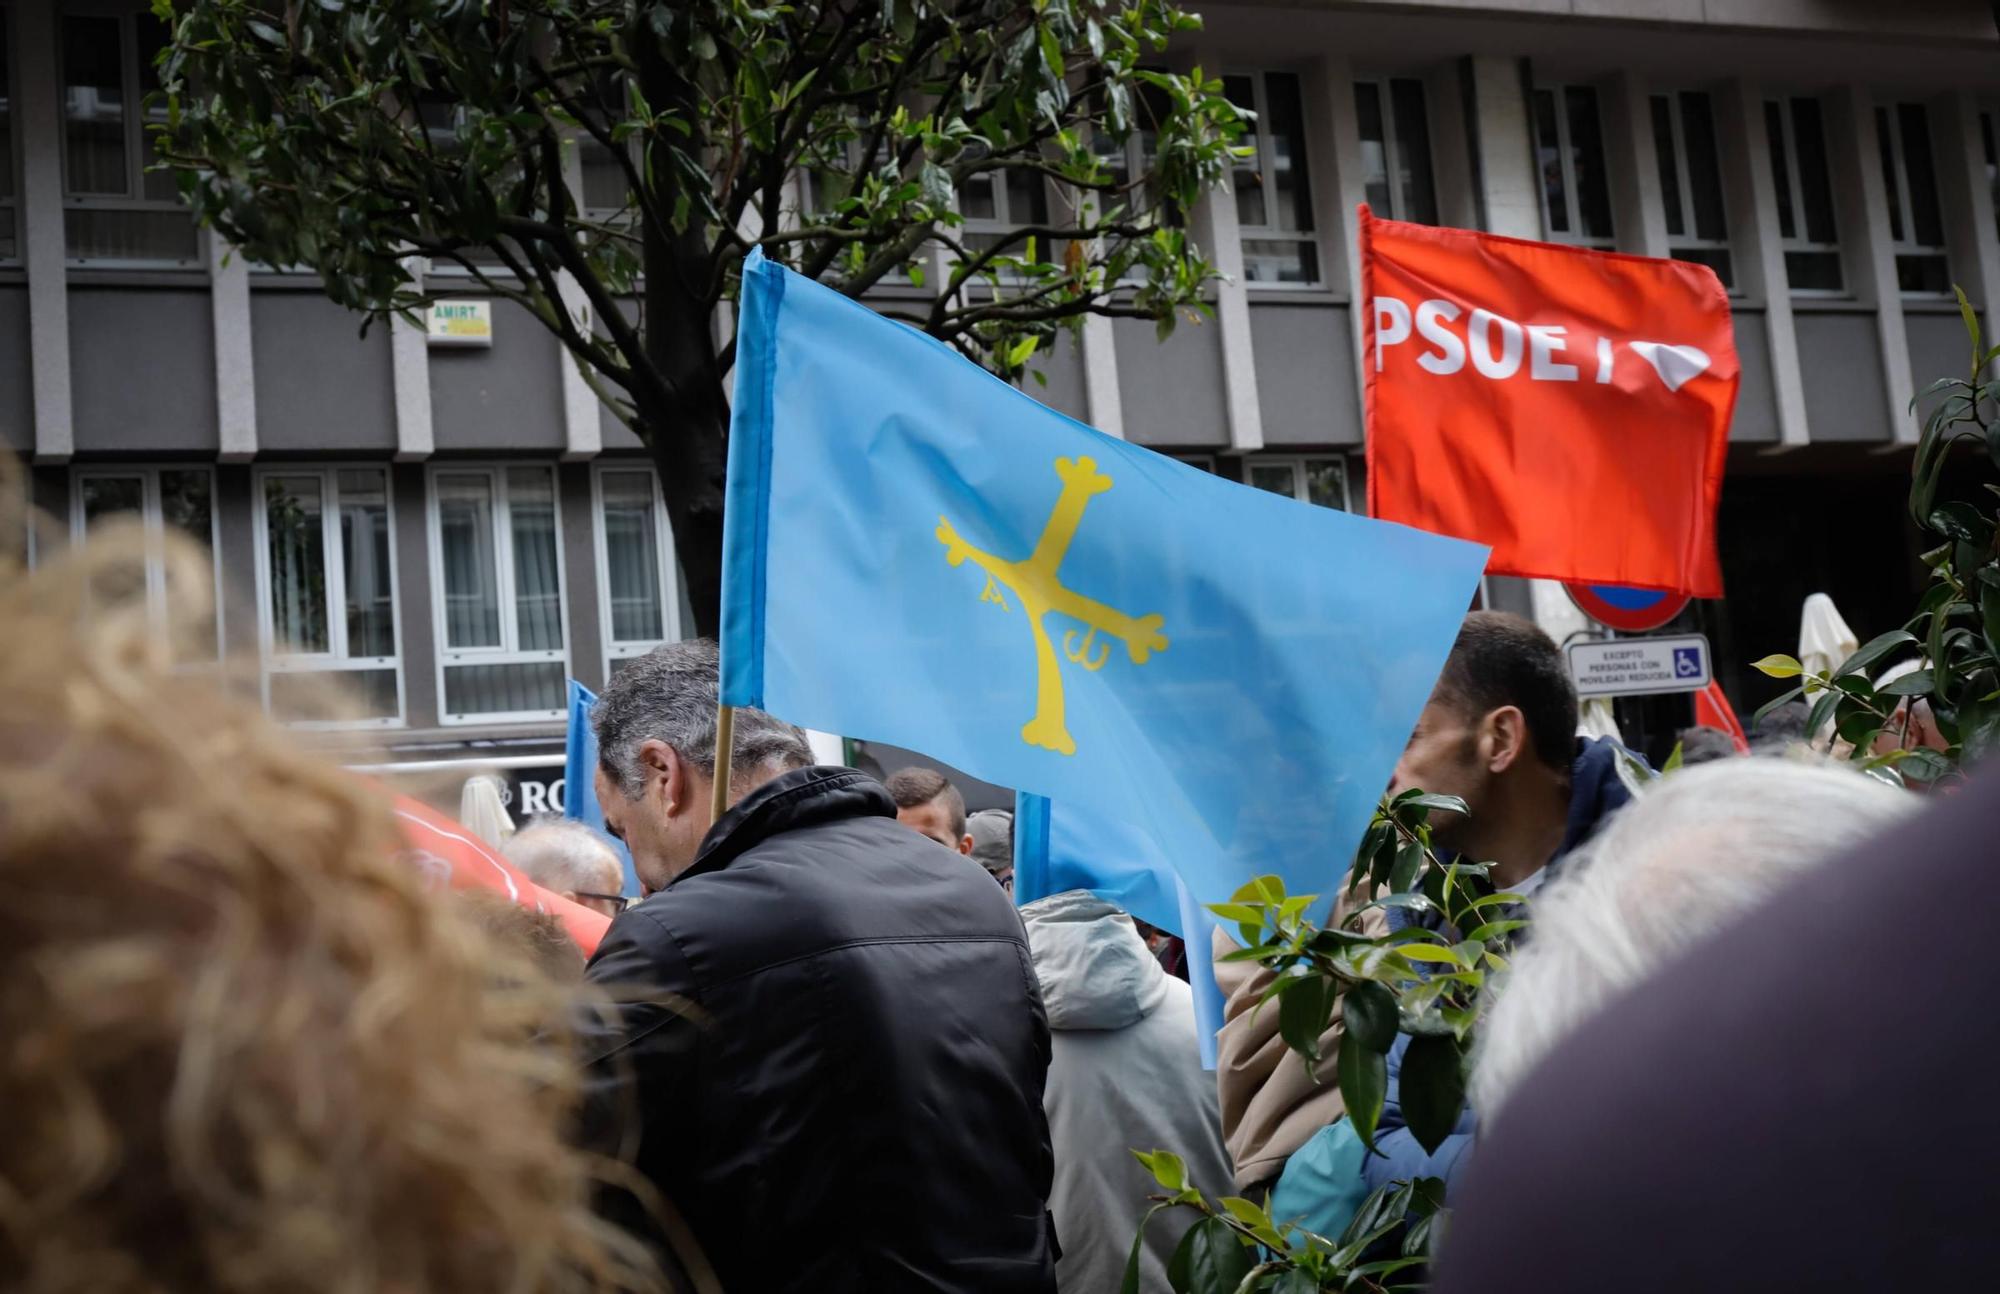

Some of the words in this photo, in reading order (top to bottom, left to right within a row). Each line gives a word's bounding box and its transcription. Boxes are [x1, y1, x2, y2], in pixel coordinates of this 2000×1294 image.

[1374, 296, 1580, 382] PSOE
[1603, 650, 1643, 660] EXCEPTO
[1589, 662, 1637, 672] PERSONAS
[1641, 661, 1660, 670] CON
[1579, 674, 1626, 685] MOVILIDAD
[1629, 672, 1672, 681] REDUCIDA
